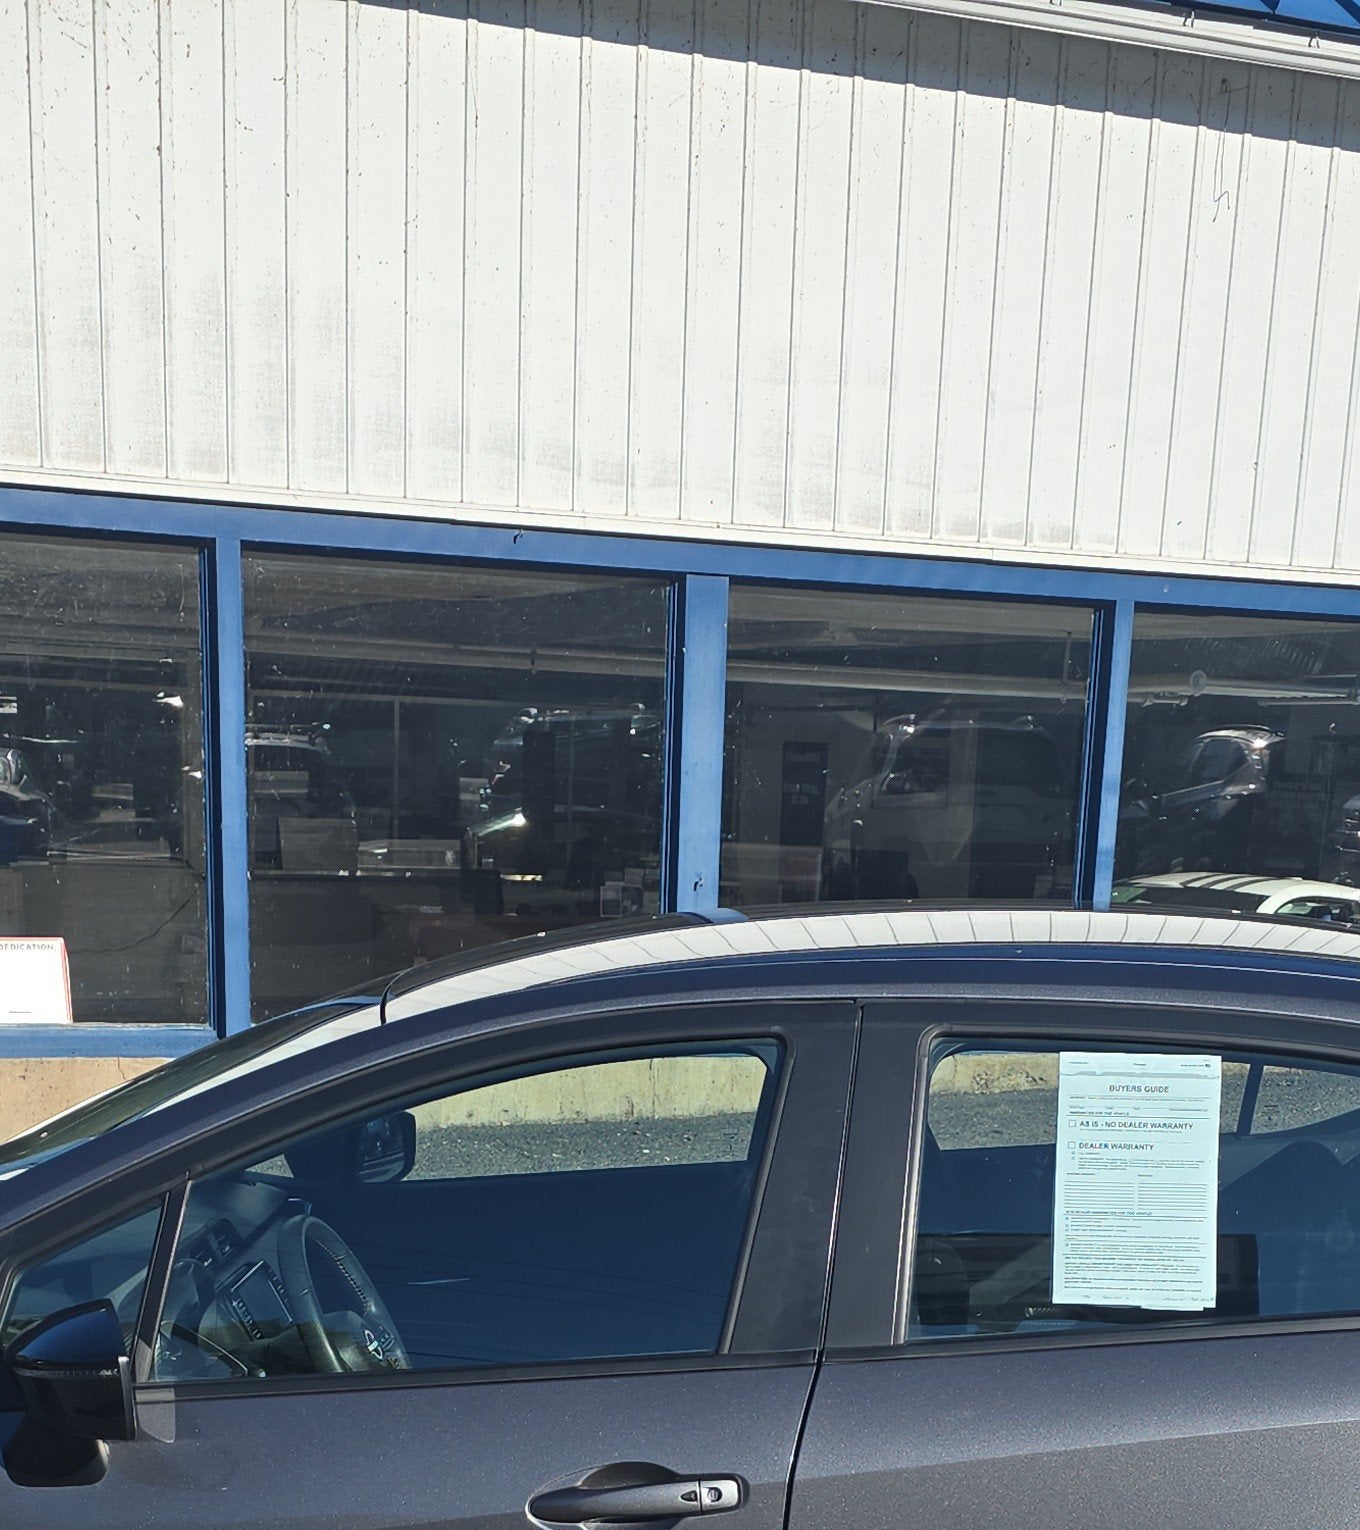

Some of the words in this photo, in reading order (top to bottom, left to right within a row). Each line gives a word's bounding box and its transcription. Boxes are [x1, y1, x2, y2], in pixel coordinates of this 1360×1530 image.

[1109, 1084, 1142, 1092] BUYERS
[1144, 1085, 1170, 1093] GUIDE
[1118, 1121, 1148, 1129] DEALER
[1150, 1122, 1194, 1130] WARRANTY
[1079, 1142, 1109, 1150] DEALER
[1111, 1142, 1154, 1151] WARRANTY
